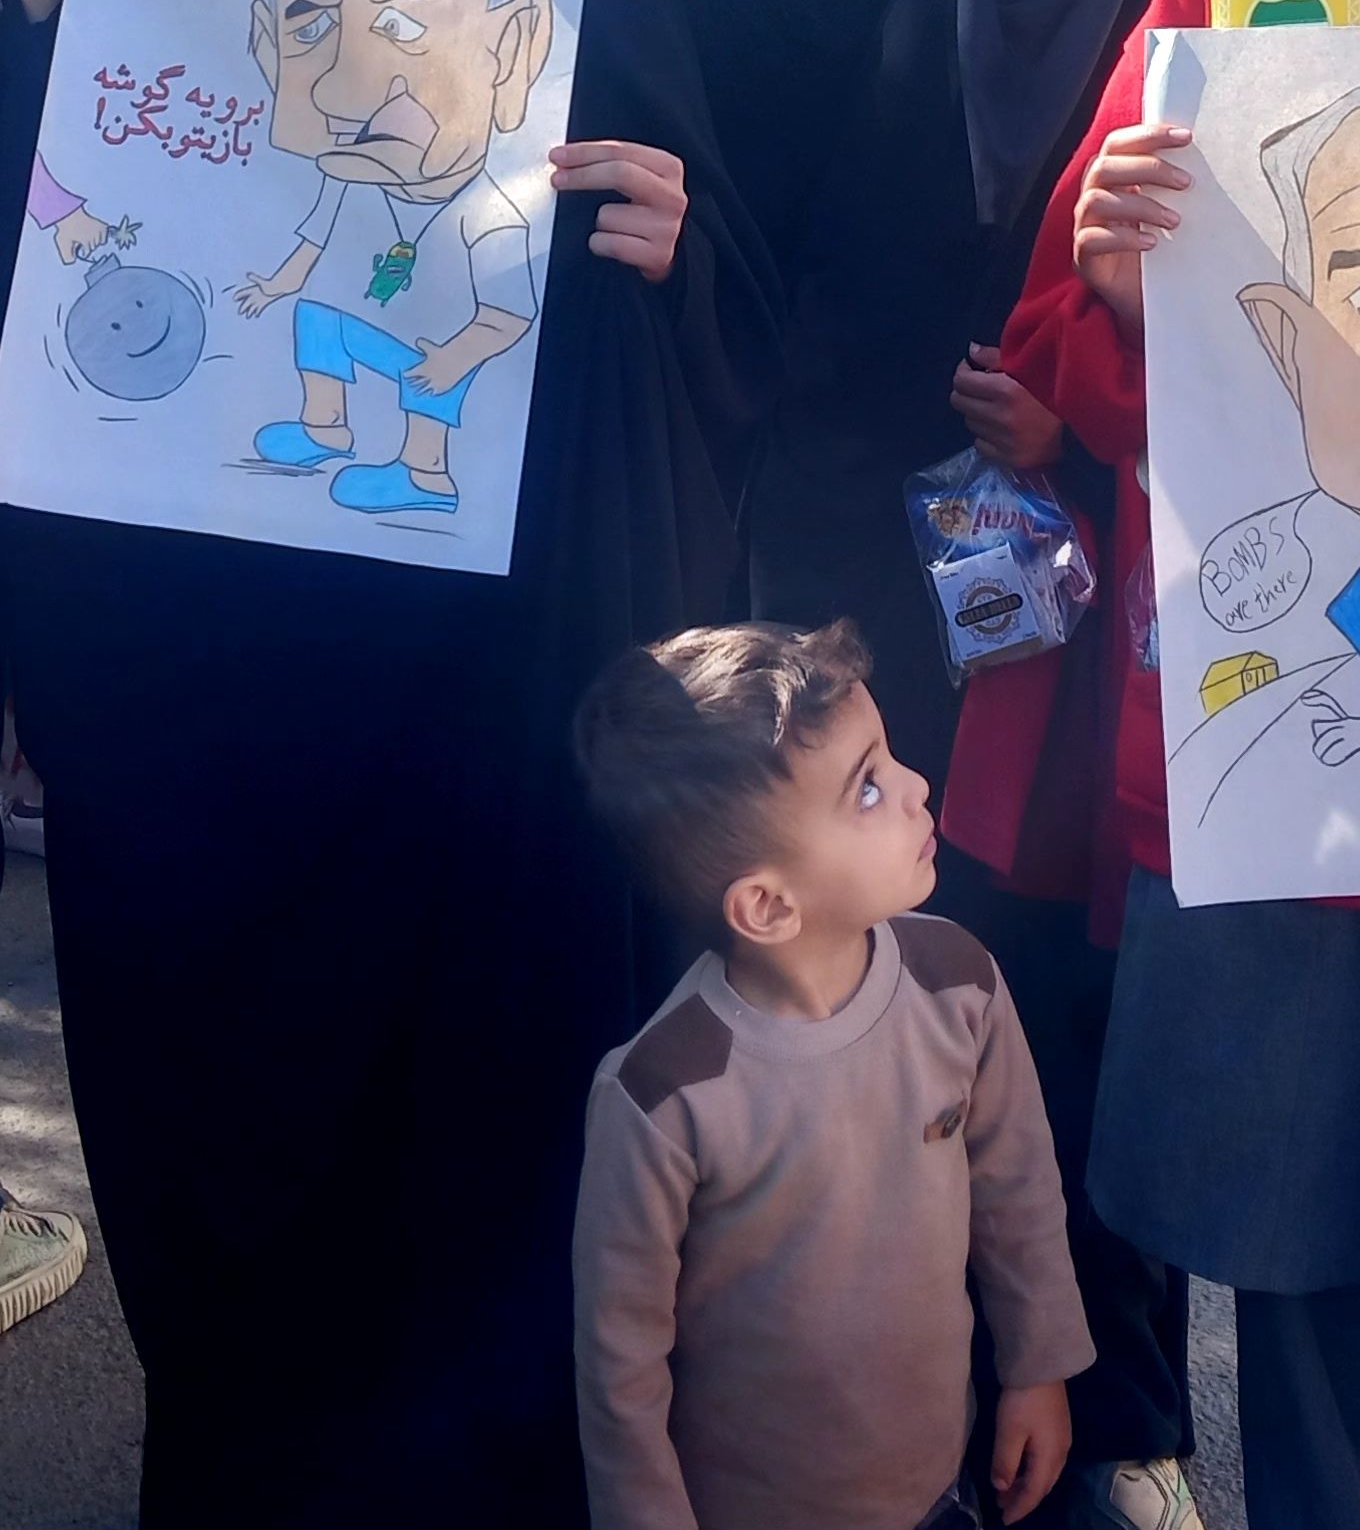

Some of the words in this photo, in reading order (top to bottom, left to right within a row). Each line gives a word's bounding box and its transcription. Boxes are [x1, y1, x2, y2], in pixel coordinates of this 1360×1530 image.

[1201, 516, 1285, 597] BOMBS
[1225, 599, 1253, 627] are
[1254, 570, 1298, 613] there
